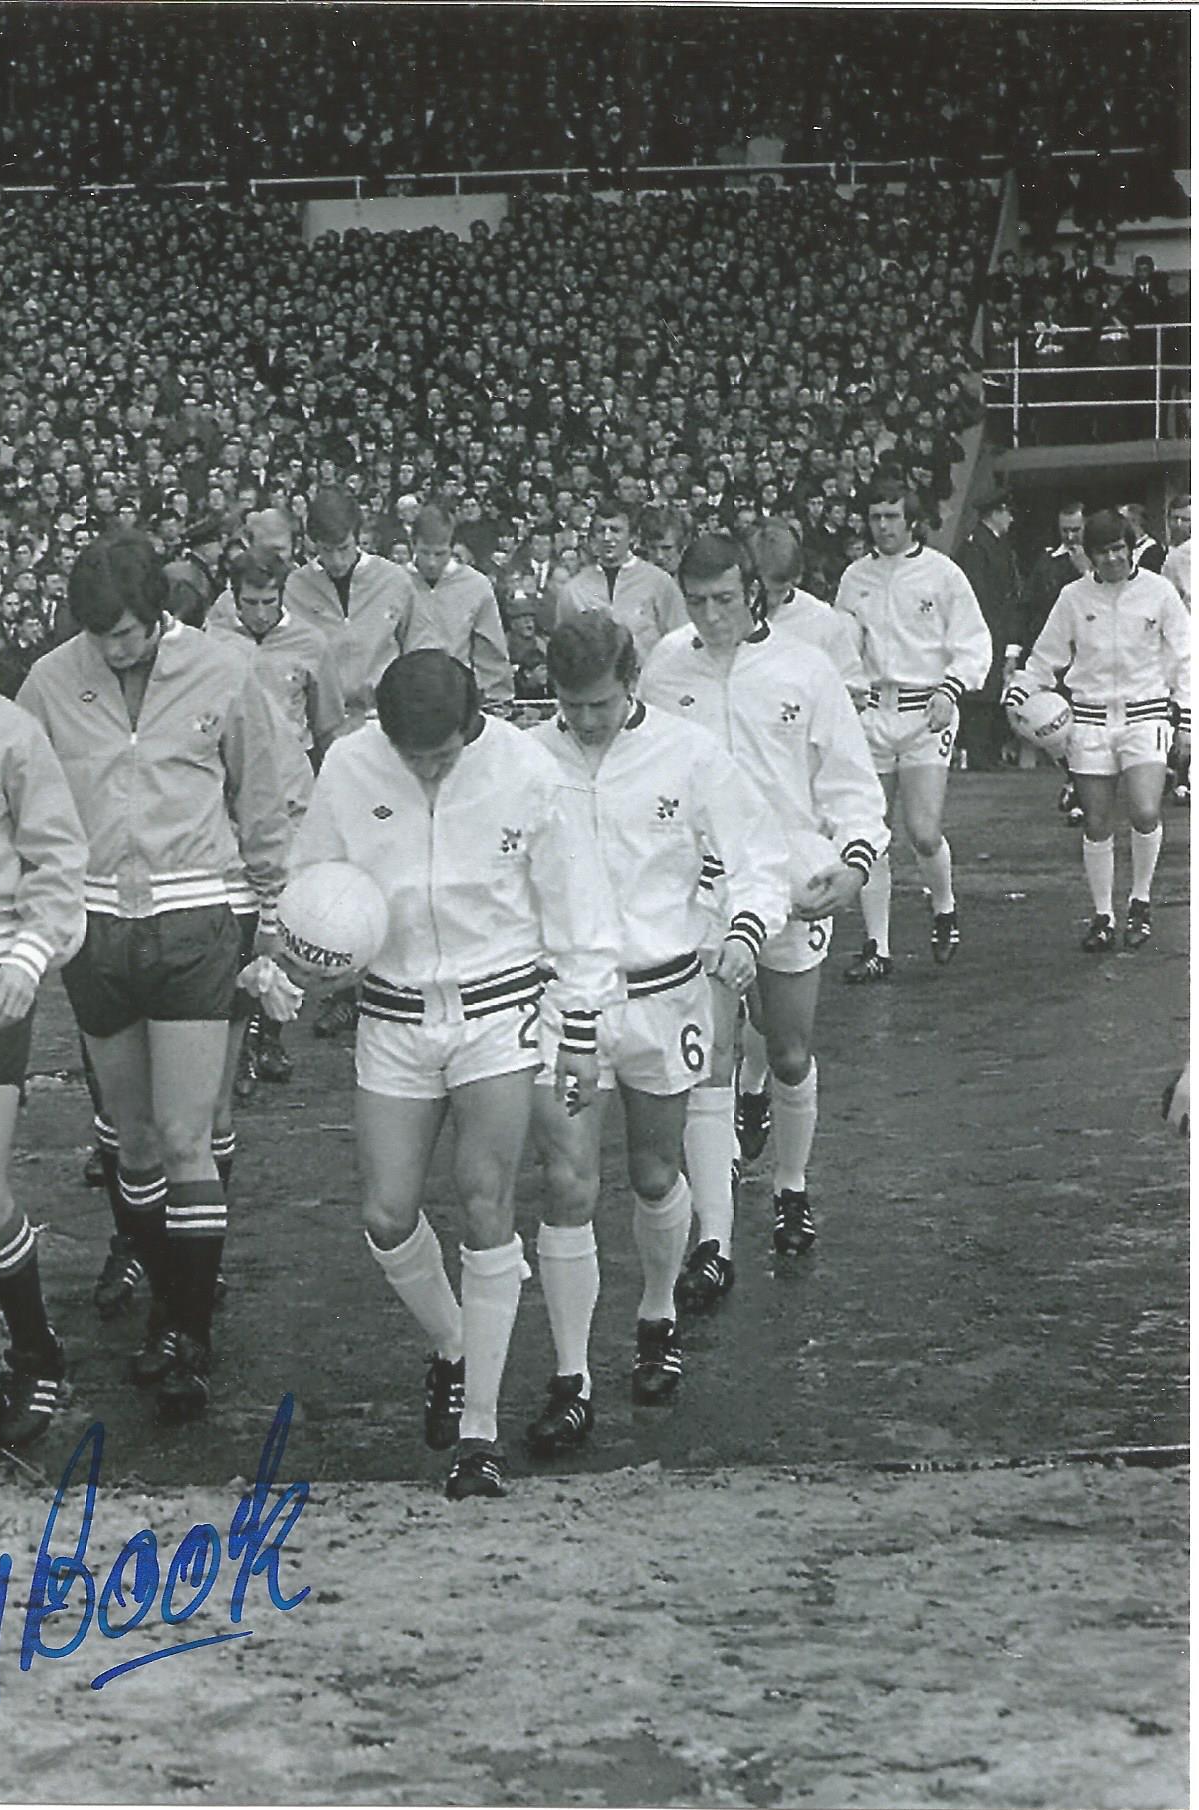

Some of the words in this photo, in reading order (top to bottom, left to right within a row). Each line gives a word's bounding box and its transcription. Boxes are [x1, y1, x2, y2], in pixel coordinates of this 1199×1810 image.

[938, 730, 952, 757] 9
[808, 920, 826, 951] 5
[518, 998, 540, 1048] 2
[680, 1023, 704, 1072] 6
[20, 1391, 312, 1671] Book
